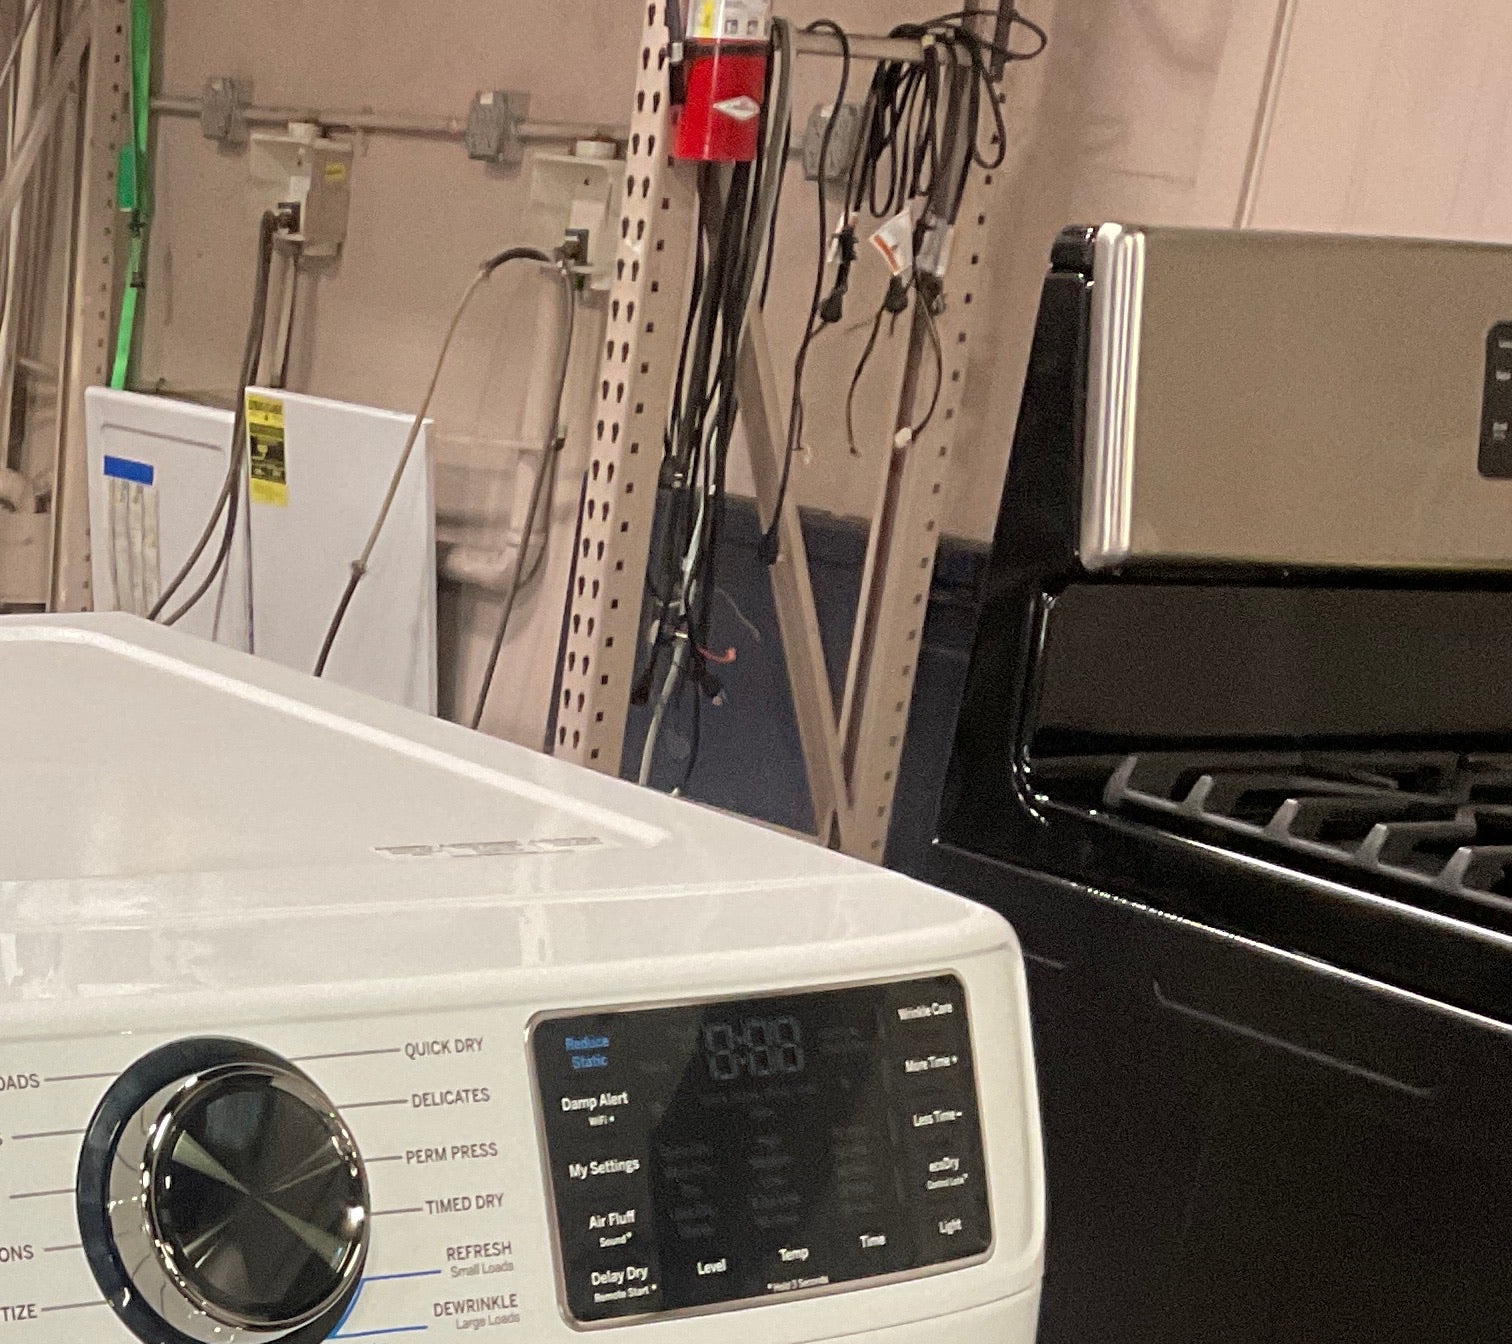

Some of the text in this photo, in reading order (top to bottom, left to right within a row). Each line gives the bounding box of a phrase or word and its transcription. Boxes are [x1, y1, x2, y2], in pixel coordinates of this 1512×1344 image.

[404, 1037, 483, 1061] QUICK DRY
[565, 1036, 610, 1050] Reduce
[571, 1054, 609, 1069] Static
[411, 1087, 491, 1108] DELICATES
[561, 1091, 629, 1112] Damp Alert
[405, 1142, 499, 1165] PERM PRESS
[568, 1159, 641, 1180] My Settings
[425, 1193, 505, 1215] TIMED DRY
[588, 1209, 636, 1231] Air Fluff
[445, 1241, 513, 1262] REFRESH
[859, 1234, 887, 1249] Time
[777, 1247, 810, 1262] Temp
[449, 1260, 515, 1279] Small Loads
[590, 1266, 649, 1286] Delay Dry
[696, 1257, 728, 1276] Level
[432, 1293, 519, 1318] DEWRINKLE
[455, 1311, 521, 1331] Large Loads
